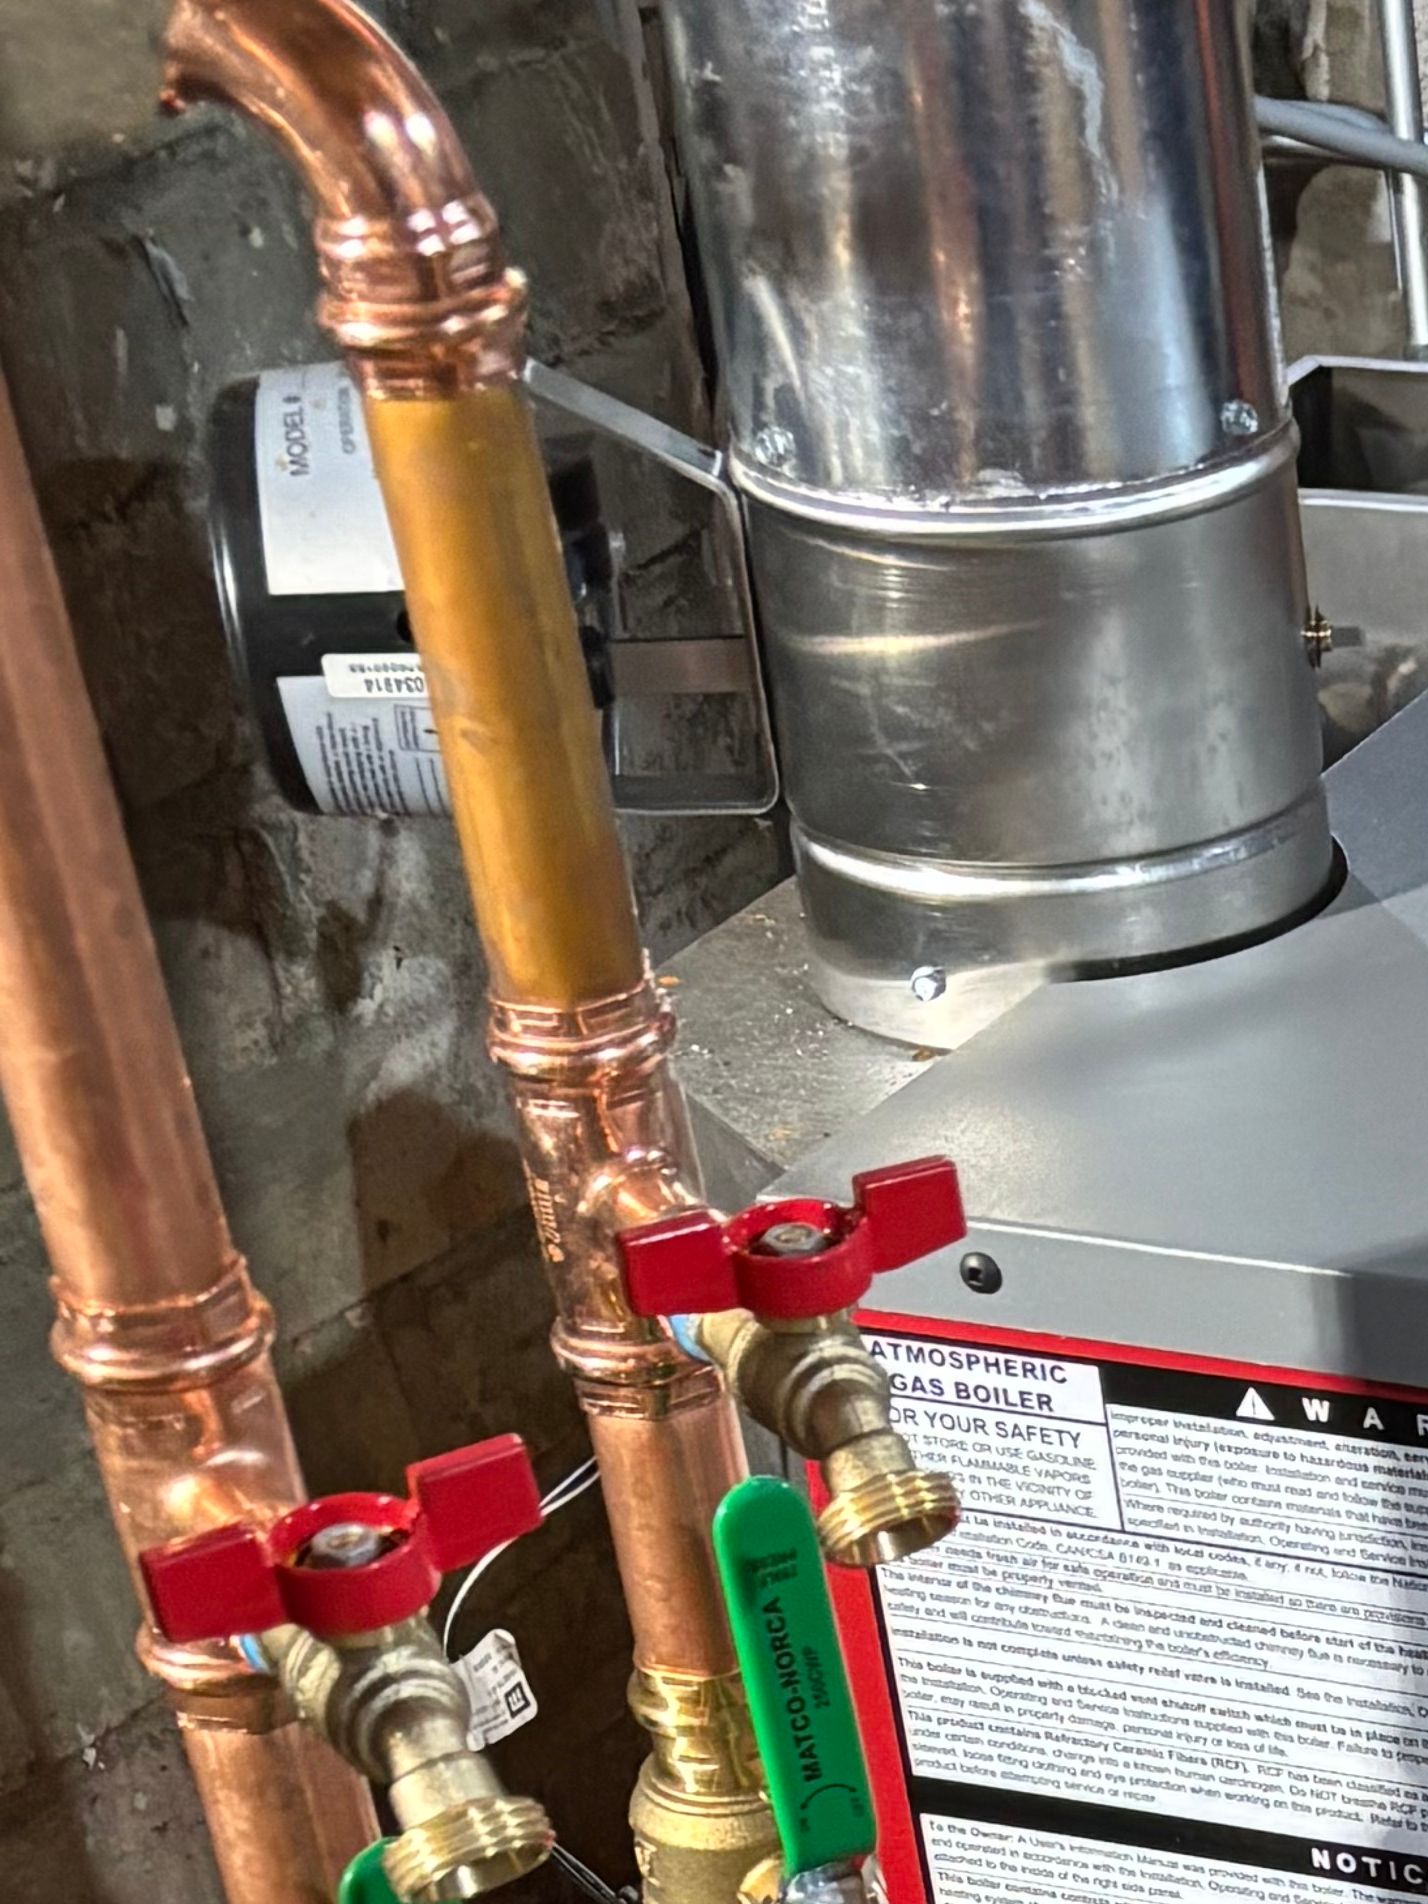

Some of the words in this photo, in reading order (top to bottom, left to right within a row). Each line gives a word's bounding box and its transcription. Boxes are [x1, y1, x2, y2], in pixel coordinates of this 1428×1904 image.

[868, 1338, 1068, 1385] ATMOSPHERIC
[889, 1371, 945, 1396] GAS
[954, 1380, 1054, 1412] BOILER
[886, 1406, 918, 1425] OR
[923, 1411, 988, 1435] YOUR
[995, 1421, 1082, 1448] SAFETY
[922, 1435, 968, 1450] STORE
[971, 1442, 992, 1454] OR
[995, 1445, 1022, 1458] USE
[1026, 1450, 1095, 1469] GASOLINE
[951, 1455, 1031, 1475] FLAMMABLE
[1033, 1467, 1091, 1484] VAPORS
[968, 1474, 982, 1484] IN
[986, 1476, 1011, 1489] THE
[1015, 1480, 1071, 1498] VICINITY
[1075, 1489, 1094, 1501] OF
[969, 1491, 1016, 1507] OTHER
[762, 1597, 822, 1782] MATCO-NORCA
